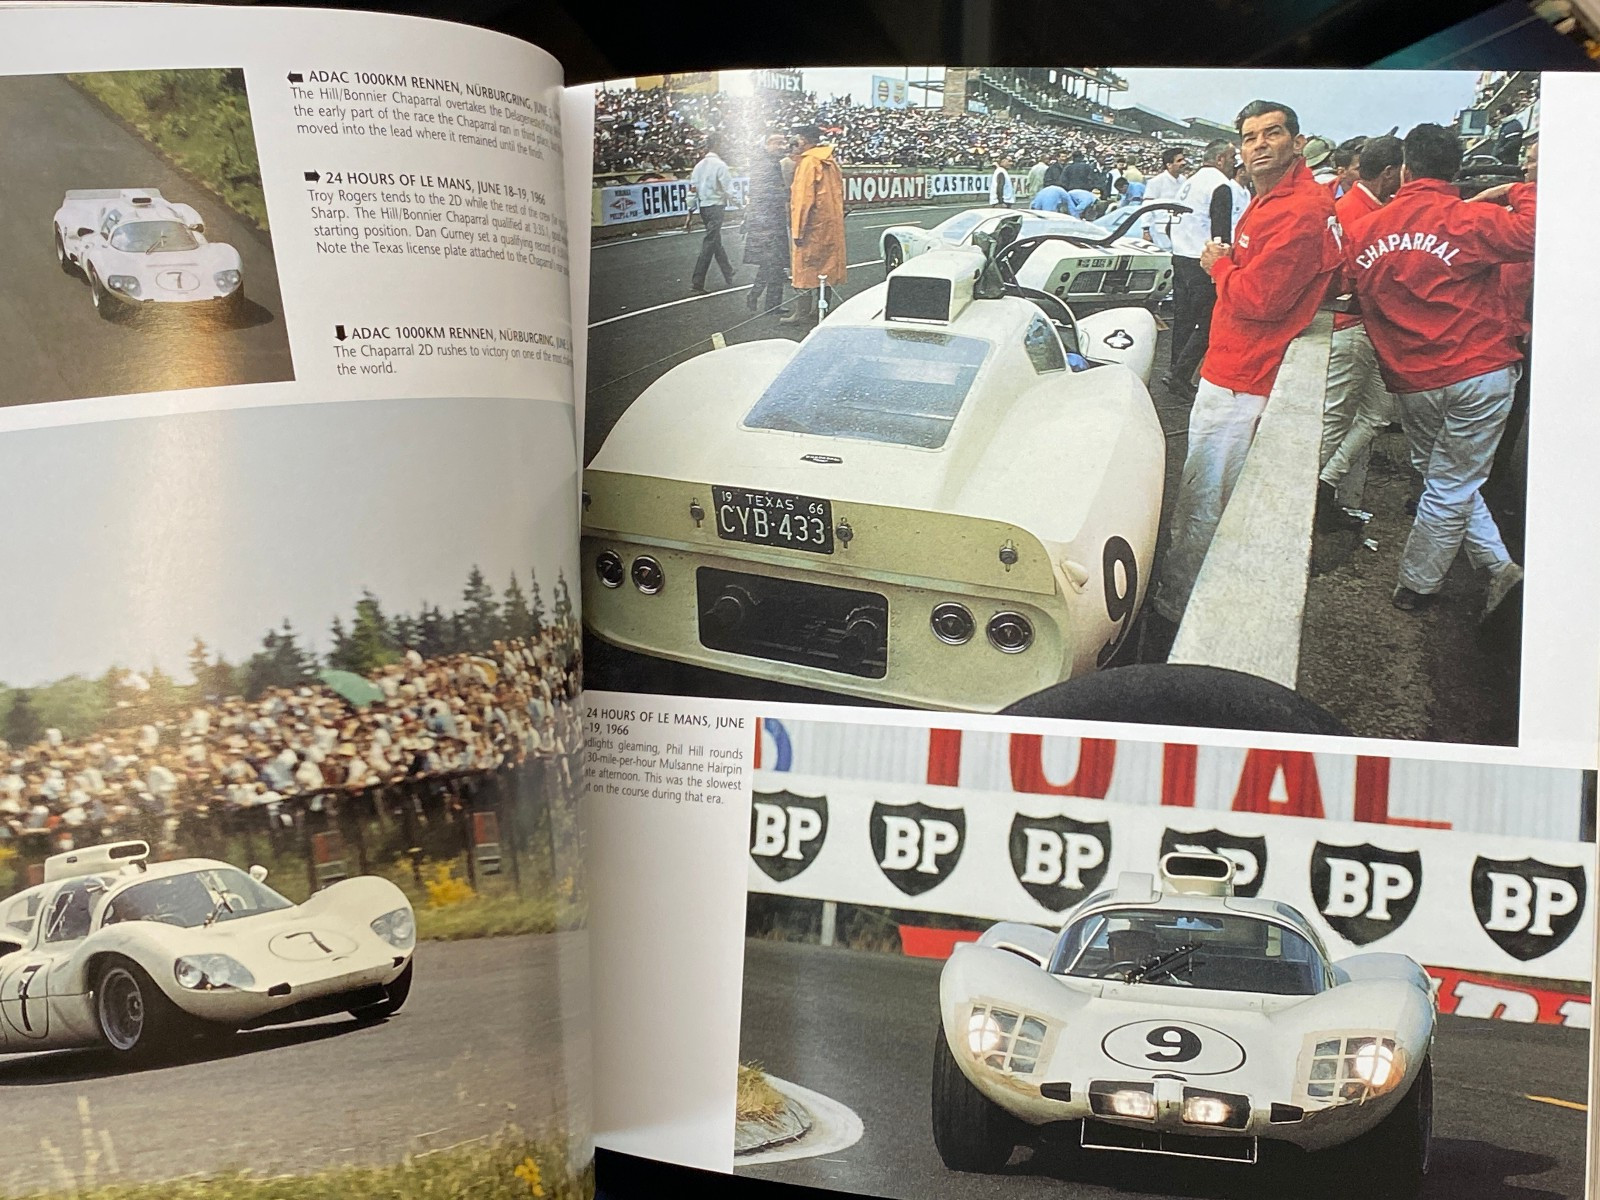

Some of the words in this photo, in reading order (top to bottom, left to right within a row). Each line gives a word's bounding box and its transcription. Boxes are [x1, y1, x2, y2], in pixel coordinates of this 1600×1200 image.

[290, 86, 314, 99] The
[320, 88, 387, 102] Hill/Bonnier
[392, 91, 441, 108] Chaparral
[446, 99, 487, 114] overtakes
[489, 104, 502, 117] the
[309, 70, 350, 83] ADAC
[354, 72, 407, 87] 1000KM
[412, 76, 463, 95] RENNEN,
[466, 83, 533, 112] NÜRBURGRING,
[293, 104, 314, 117] the
[318, 105, 346, 121] early
[351, 108, 374, 121] part
[378, 107, 388, 119] of
[392, 108, 410, 121] the
[413, 112, 435, 123] race
[438, 112, 454, 126] the
[457, 115, 497, 132] Chaparral
[499, 124, 511, 135] ran
[297, 122, 338, 134] moved
[342, 122, 366, 135] into
[368, 123, 387, 136] the
[390, 124, 413, 138] lead
[415, 127, 446, 141] where
[449, 129, 456, 142] it
[459, 133, 498, 149] remained
[500, 140, 515, 152] until
[517, 142, 528, 155] the
[325, 171, 343, 184] 24
[347, 172, 395, 186] HOURS
[399, 174, 416, 187] OF
[420, 175, 434, 188] LE
[437, 176, 475, 194] MANS,
[477, 180, 501, 195] JUNE
[530, 191, 546, 205] 1966
[934, 176, 989, 193] CASTROL
[307, 189, 333, 205] Troy
[338, 189, 378, 205] Rogers
[381, 191, 411, 203] tends
[414, 192, 425, 204] to
[428, 192, 445, 205] the
[448, 194, 462, 206] 2D
[465, 196, 488, 210] while
[490, 199, 503, 212] the
[505, 203, 518, 214] rest
[311, 206, 349, 222] Sharp.
[353, 206, 376, 219] The
[380, 207, 442, 222] Hill/Bonnier
[446, 210, 489, 227] Chaparral
[491, 216, 522, 231] qualified
[524, 222, 531, 233] at
[314, 224, 359, 239] starting
[364, 224, 412, 239] position.
[415, 225, 436, 238] Dan
[440, 226, 474, 243] Gurney
[477, 231, 491, 242] set
[492, 234, 498, 243] a
[500, 234, 533, 252] qualifying
[1355, 232, 1461, 270] CHAPARRAL
[316, 241, 347, 254] Note
[350, 241, 370, 254] the
[372, 241, 404, 254] Texas
[406, 242, 441, 255] license
[444, 243, 467, 259] plate
[469, 246, 505, 260] attached
[506, 250, 515, 262] to
[516, 251, 528, 264] the
[166, 271, 183, 289] 7
[352, 327, 391, 339] ADAC
[395, 326, 446, 339] 1000KM
[449, 327, 497, 342] RENNEN,
[333, 345, 357, 358] The
[360, 344, 414, 360] Chaparral
[418, 344, 433, 356] 2D
[437, 344, 467, 356] rushes
[469, 345, 480, 357] to
[481, 345, 509, 360] victory
[511, 348, 521, 358] on
[522, 349, 535, 360] one
[337, 362, 357, 375] the
[360, 361, 397, 374] world.
[721, 490, 733, 503] 19
[745, 493, 795, 511] TEXAS
[808, 503, 824, 515] 66
[1097, 535, 1138, 670] 9
[586, 707, 598, 718] 24
[601, 709, 636, 721] HOURS
[640, 711, 654, 722] OF
[658, 712, 669, 724] LE
[674, 713, 711, 728] MANS,
[715, 716, 745, 729] JUNE
[606, 723, 629, 736] 1966
[618, 740, 661, 756] gleaming,
[666, 743, 683, 755] Phil
[688, 745, 704, 757] Hill
[710, 748, 743, 760] rounds
[587, 751, 656, 768] 30-mile-per-hour
[659, 758, 704, 772] Mulsanne
[707, 762, 742, 777] Hairpin
[598, 767, 640, 782] afternoon.
[644, 771, 662, 784] This
[666, 776, 683, 786] was
[687, 775, 703, 787] the
[706, 776, 742, 791] slowest
[593, 784, 604, 793] on
[606, 783, 619, 795] the
[621, 787, 649, 797] course
[651, 788, 681, 804] during
[685, 790, 703, 803] that
[706, 795, 724, 804] era.
[750, 803, 823, 861] BP
[881, 815, 959, 875] BP
[1020, 828, 1104, 891] BP
[1324, 856, 1414, 921] BP
[1485, 872, 1578, 937] BP
[285, 931, 332, 953] 7
[1145, 1026, 1202, 1063] 9
